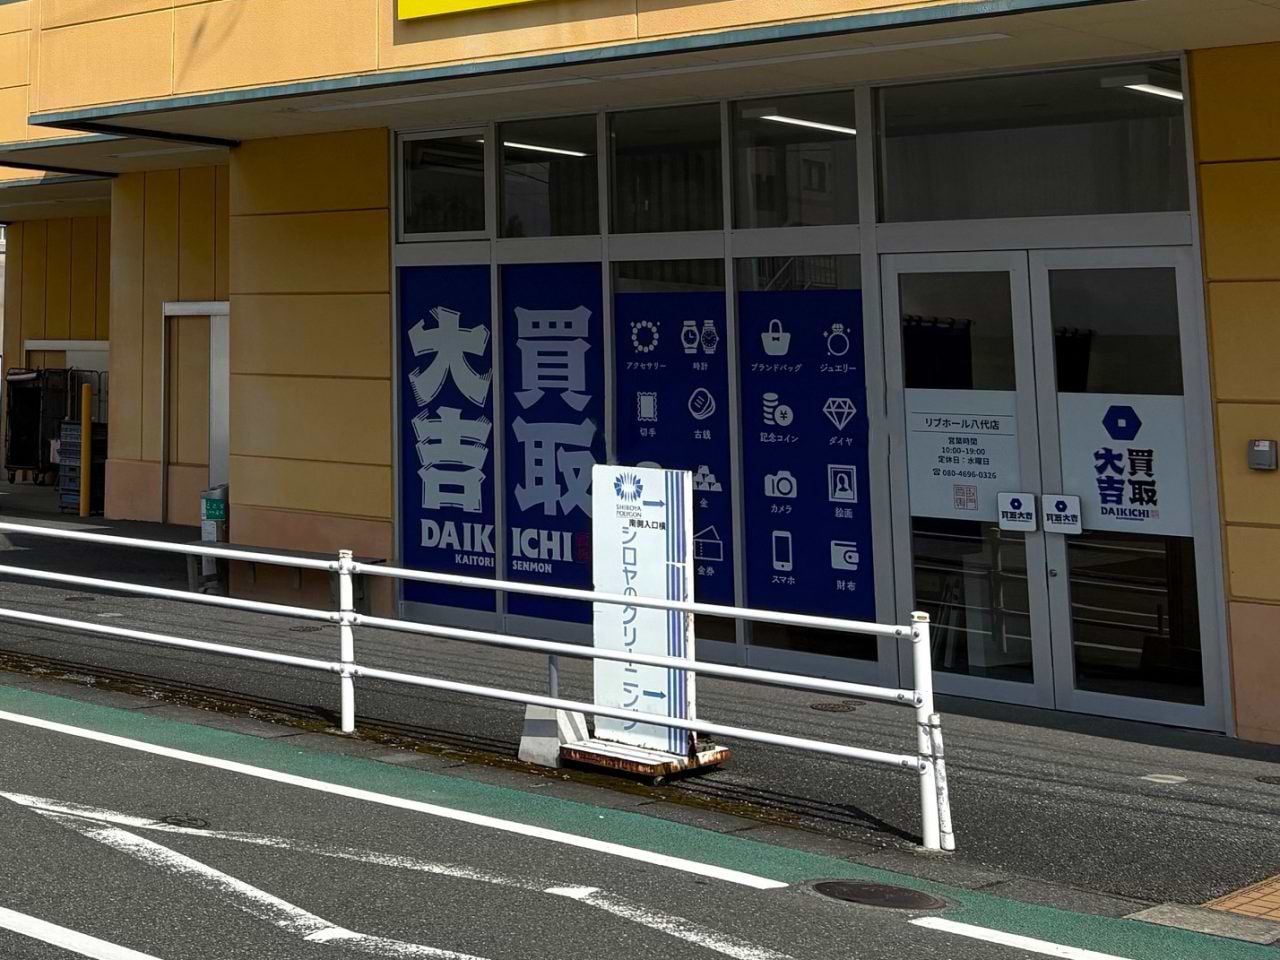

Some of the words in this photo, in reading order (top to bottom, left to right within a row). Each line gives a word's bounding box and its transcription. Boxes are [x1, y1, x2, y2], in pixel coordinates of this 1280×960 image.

[626, 361, 667, 371] アクセサリー
[692, 362, 709, 371] 時計
[751, 363, 803, 373] ブランドバッグ
[820, 363, 857, 373] ジュエリー
[408, 306, 493, 514] 大吉
[512, 305, 597, 518] 買取
[925, 418, 1000, 431] リブホール八代店
[639, 427, 657, 438] 切手
[693, 429, 712, 440] 古銭
[759, 431, 799, 443] 記念コイン
[829, 436, 853, 446] ダイヤ
[948, 437, 978, 445] 営業時間
[1093, 447, 1126, 505] 大吉
[1127, 448, 1158, 506] 買取
[770, 504, 793, 514] カメラ
[834, 507, 854, 519] 絵画
[1100, 507, 1150, 518] DAIKICHI
[455, 553, 495, 568] KAITORI
[512, 560, 552, 574] SENMON
[697, 565, 715, 576] 金券
[771, 575, 796, 585] スマホ
[836, 580, 857, 591] 財布
